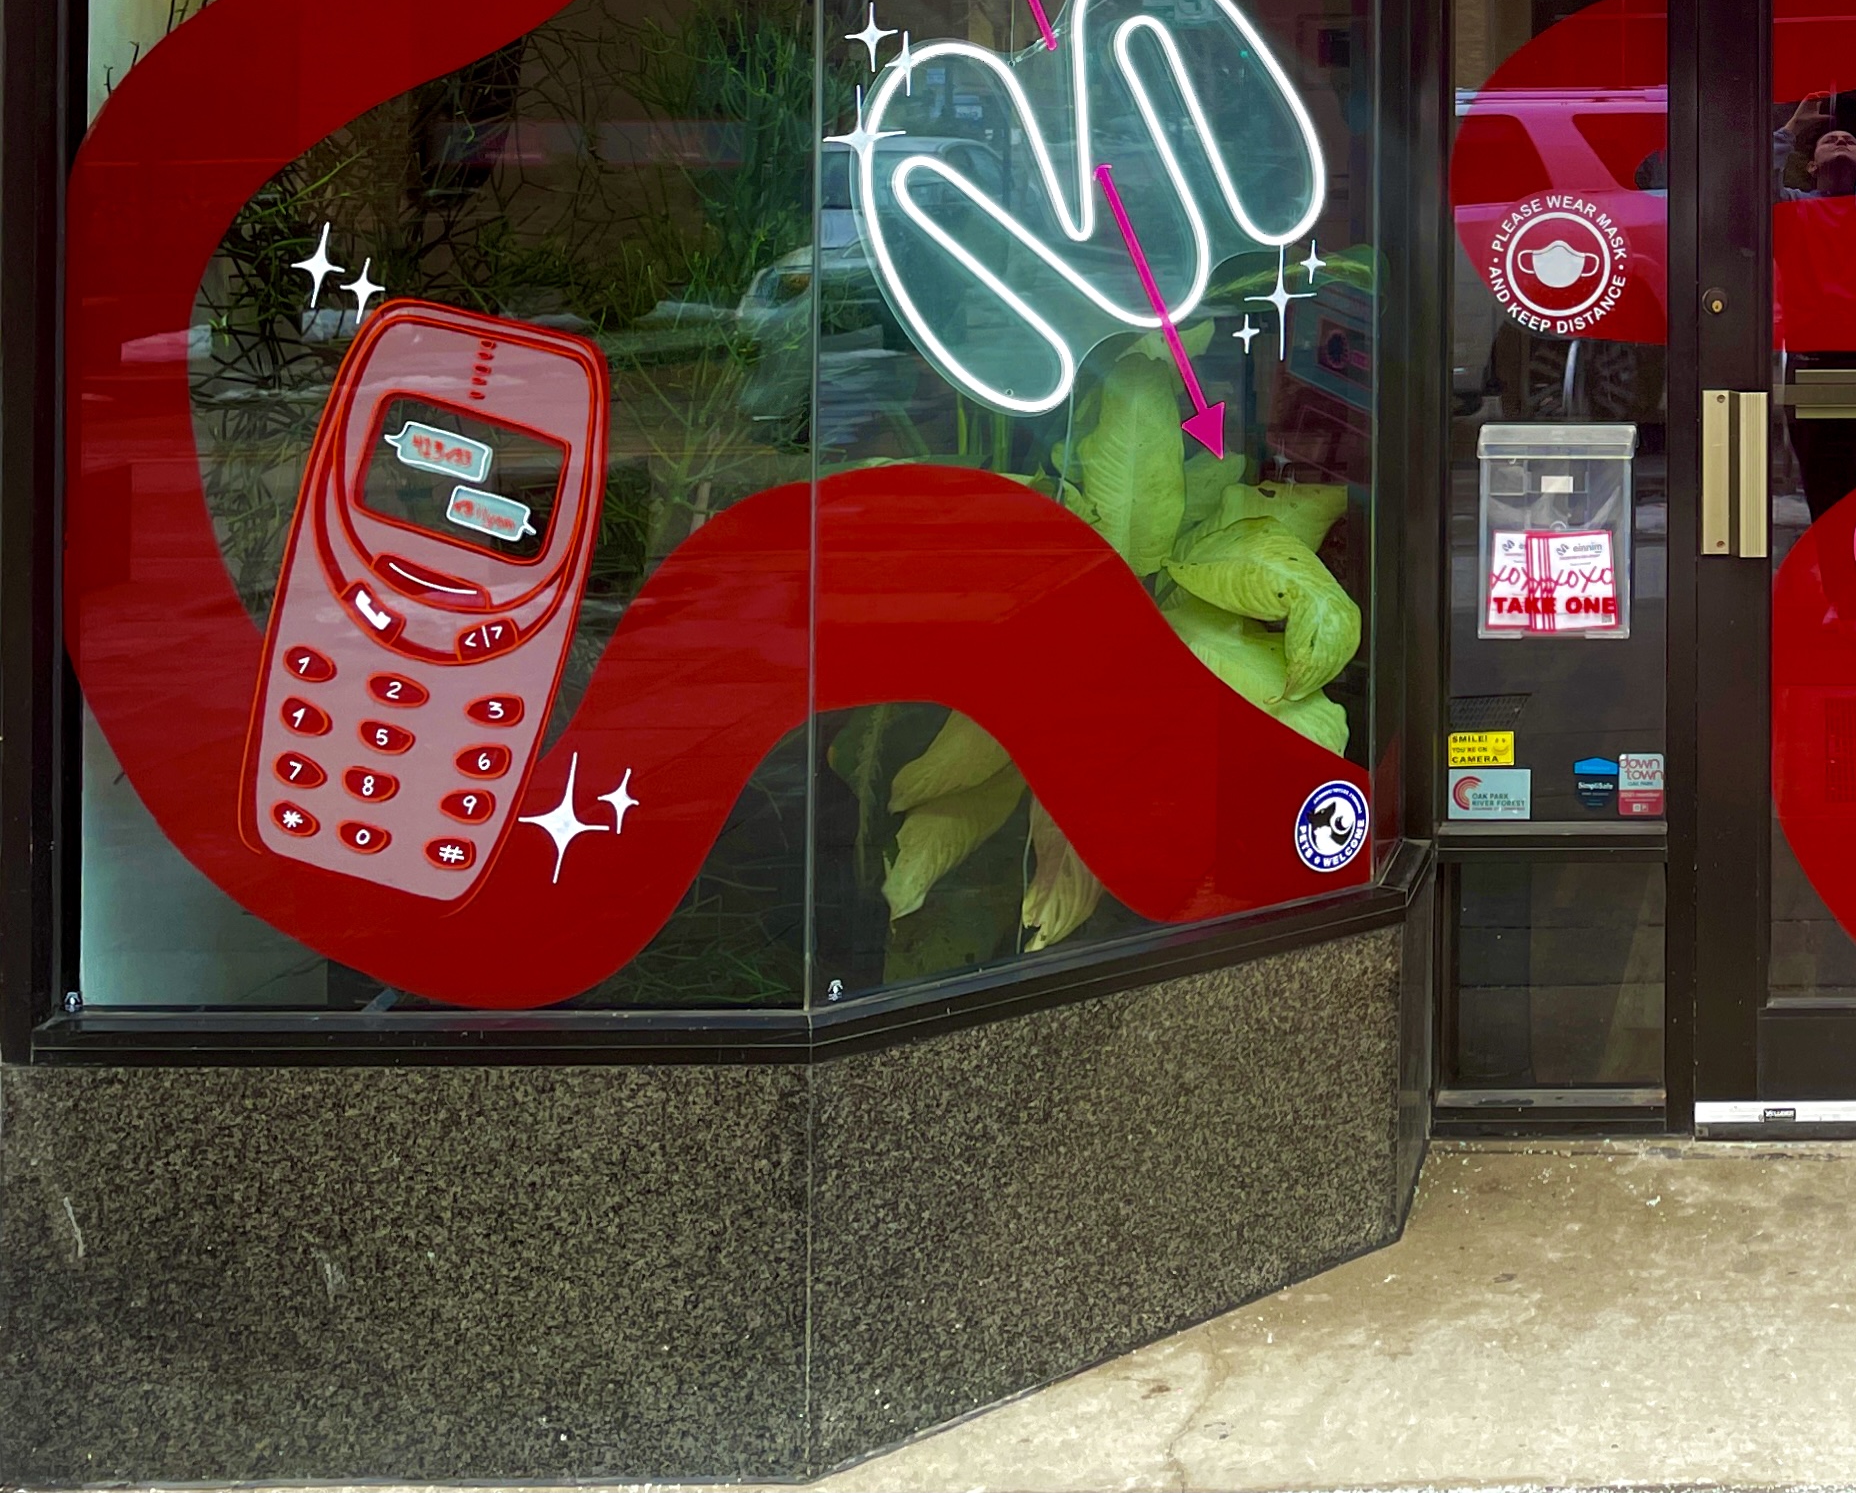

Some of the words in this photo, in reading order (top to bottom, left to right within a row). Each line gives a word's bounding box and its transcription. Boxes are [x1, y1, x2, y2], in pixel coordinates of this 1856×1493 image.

[1492, 198, 1543, 252] PLEASE
[1546, 195, 1597, 217] WEAR
[1596, 213, 1627, 260] MASK
[1489, 266, 1511, 303] AND
[1507, 302, 1552, 332] KEEP
[1556, 274, 1626, 334] DISTANCE
[1493, 597, 1557, 614] TAKE
[1565, 597, 1616, 614] ONE
[386, 681, 403, 699] 2
[488, 701, 504, 719] 3
[375, 728, 389, 746] 5
[1452, 735, 1488, 743] SMILE!
[477, 752, 491, 771] 6
[1451, 756, 1499, 764] CAMERA
[1619, 754, 1660, 770] down
[288, 760, 304, 781] 7
[1624, 769, 1664, 781] town
[361, 775, 375, 796] 8
[462, 795, 478, 815] 9
[1300, 825, 1315, 859] PETS
[1323, 819, 1365, 867] WELCOME
